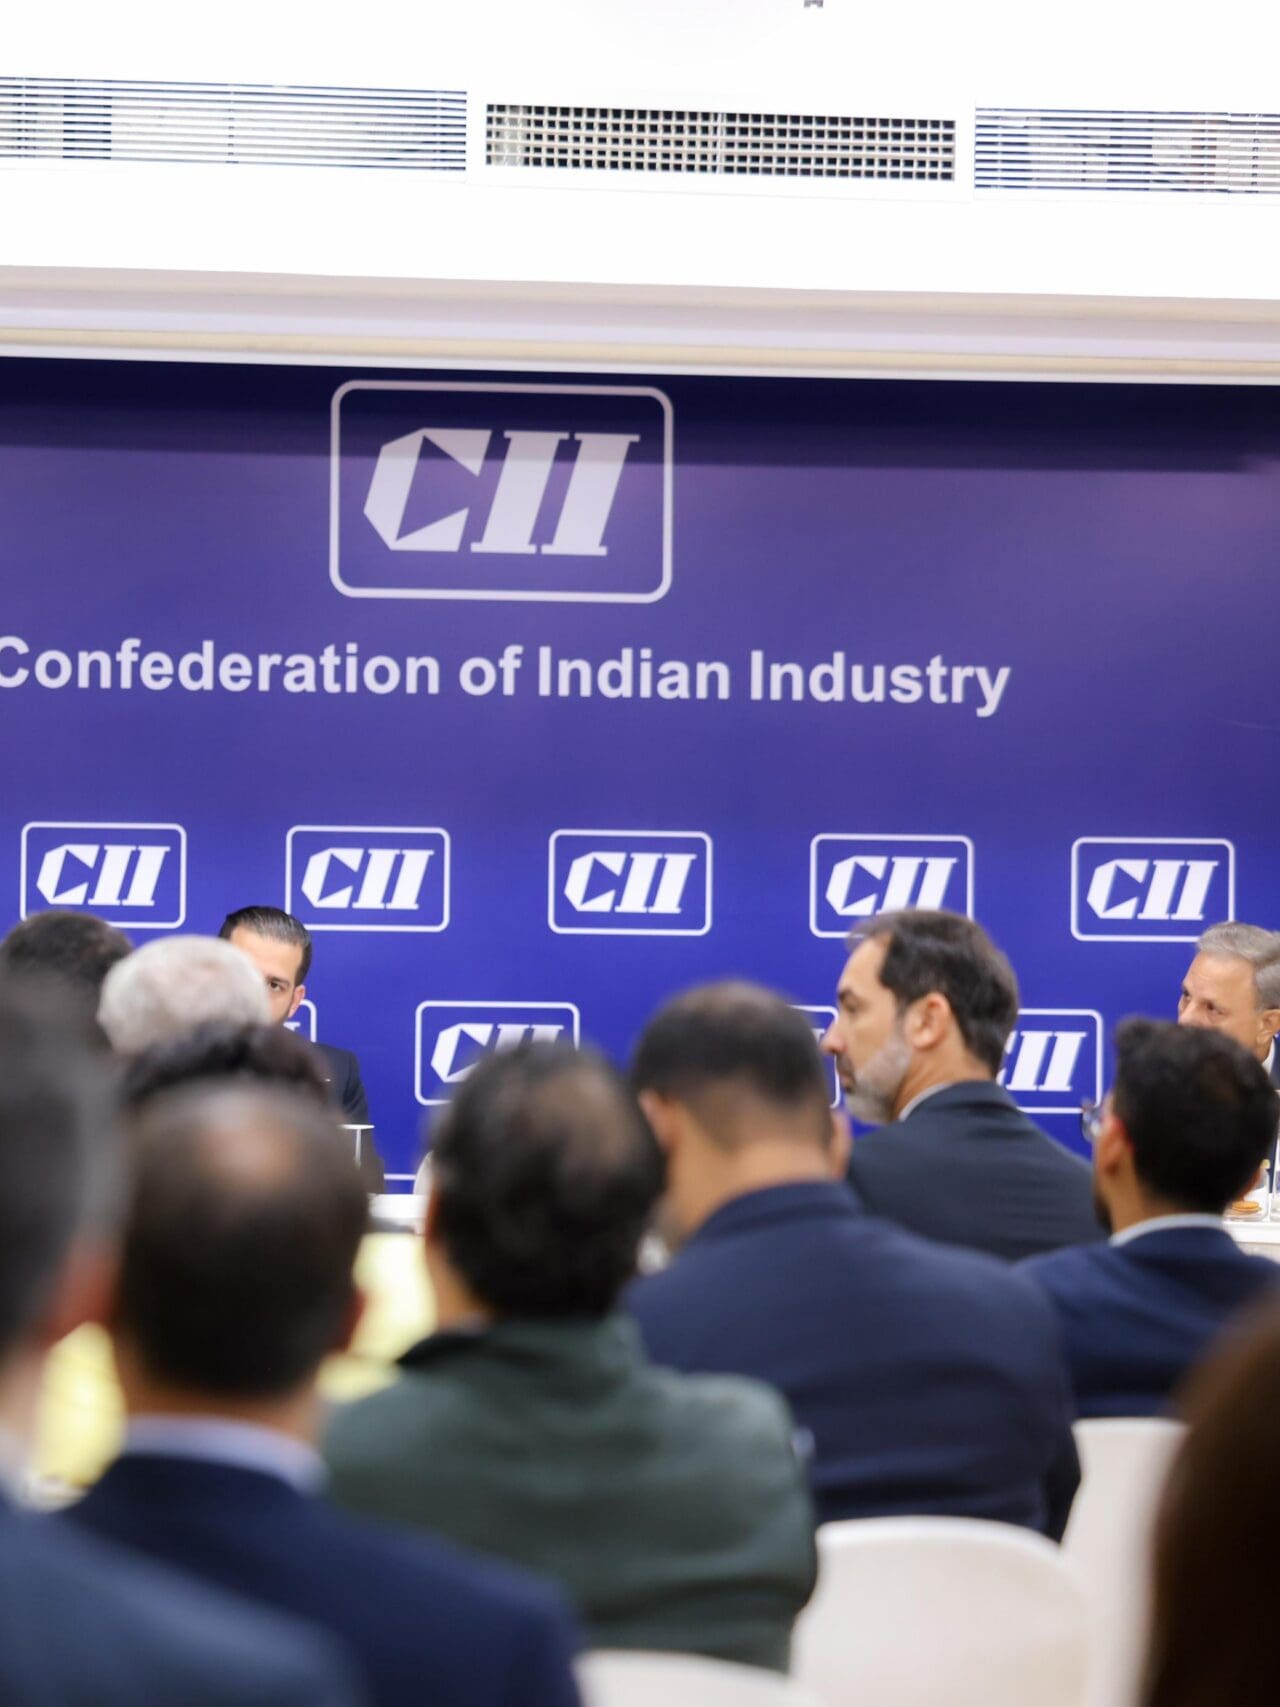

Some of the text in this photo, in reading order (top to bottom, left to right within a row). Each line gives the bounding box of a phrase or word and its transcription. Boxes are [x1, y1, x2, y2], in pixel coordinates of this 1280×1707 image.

[363, 428, 641, 557] CII
[459, 645, 524, 696] of
[538, 646, 730, 700] Indian
[750, 651, 1011, 718] Industry
[36, 843, 171, 907] CII
[300, 847, 435, 911] CII
[563, 851, 697, 914] CII
[825, 855, 959, 918] CII
[1086, 858, 1219, 921] CII
[995, 1030, 1088, 1092] II
